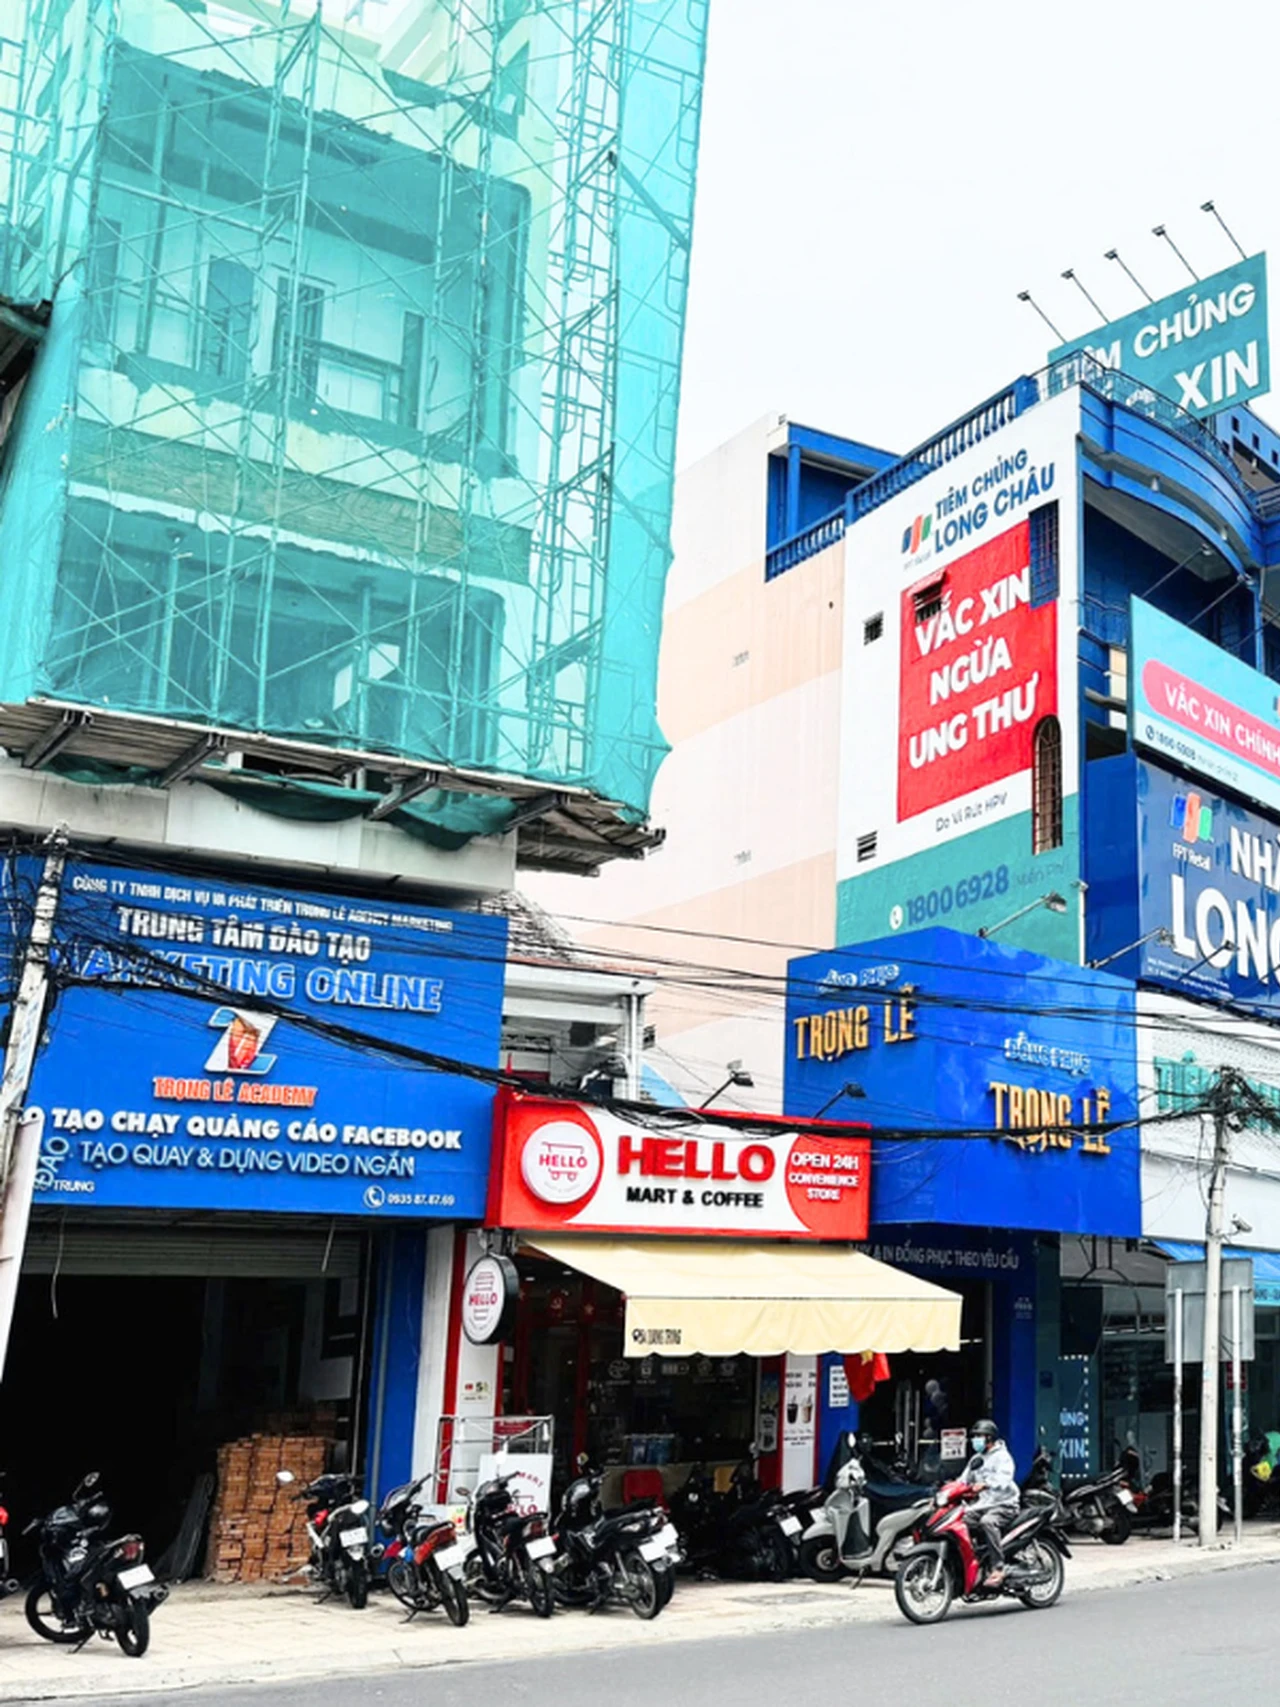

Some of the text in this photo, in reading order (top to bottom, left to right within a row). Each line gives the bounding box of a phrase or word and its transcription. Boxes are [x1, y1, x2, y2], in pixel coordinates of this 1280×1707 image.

[1133, 282, 1256, 358] CHỦNG
[1173, 339, 1259, 419] XIN
[935, 448, 1028, 520] TIÊM CHỦNG
[935, 462, 1056, 554] LONG CHÂU
[914, 566, 1031, 657] VẮC XIN
[929, 634, 1013, 706] NGỪA
[908, 670, 1040, 770] UNG THƯ
[1163, 681, 1200, 722] VẮC
[1203, 703, 1232, 739] XIN
[1172, 841, 1188, 862] FPT
[110, 879, 127, 895] TY
[129, 882, 162, 899] TNHH
[115, 904, 372, 966] TRUNG TÂM ĐÀO TẠO
[305, 965, 444, 1014] ONLINE
[793, 981, 915, 1061] TRỌNG LÊ
[152, 1075, 319, 1108] TRỌNG LÊ ACADEMY
[51, 1107, 105, 1135] TẠO
[111, 1109, 181, 1139] CHẠY
[185, 1112, 281, 1141] QUẢNG
[286, 1116, 338, 1144] CÁO
[341, 1124, 463, 1151] FACEBOOK
[988, 1080, 1112, 1154] TRỌNG LÊ
[79, 1140, 415, 1177] TẠO QUAY & DỰNG VIDEO NGẮN
[538, 1153, 589, 1169] HELLO
[616, 1134, 777, 1183] HELLO
[787, 1172, 860, 1188] CONVENIENCE
[789, 1151, 860, 1171] OPEN 24H
[52, 1178, 96, 1193] TRUNG
[625, 1185, 765, 1208] MART & COFFEE
[805, 1187, 842, 1202] STORE
